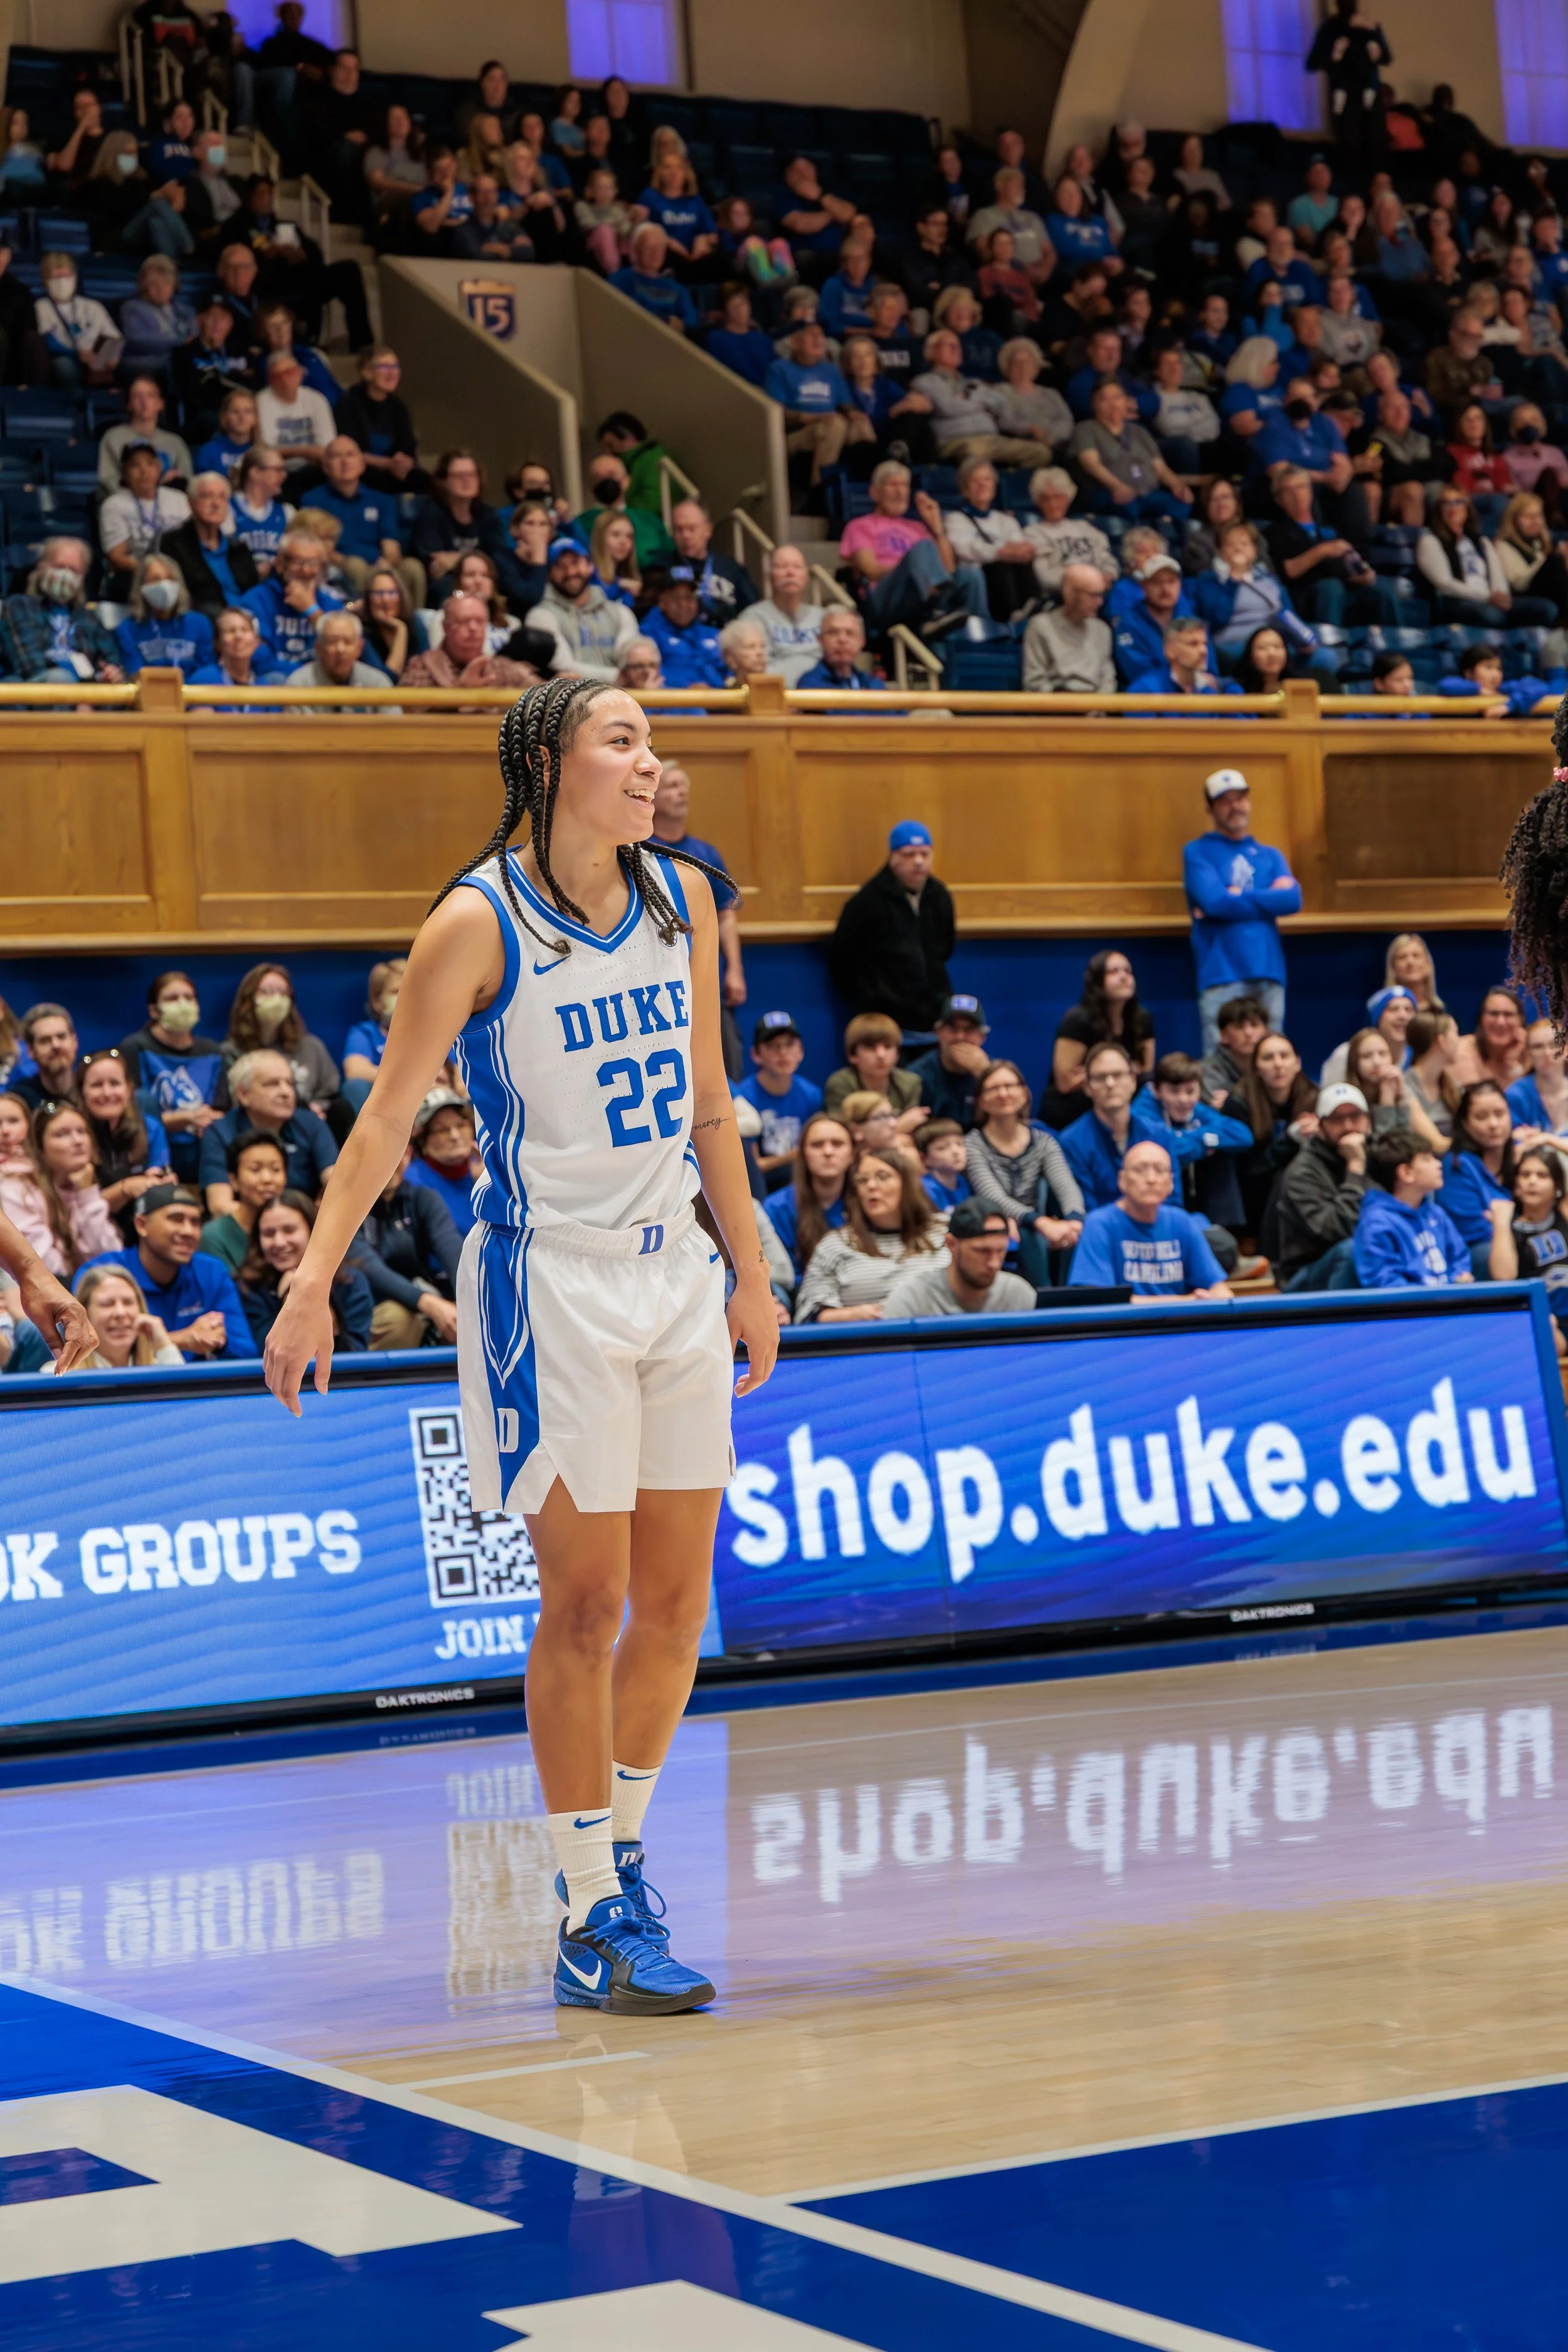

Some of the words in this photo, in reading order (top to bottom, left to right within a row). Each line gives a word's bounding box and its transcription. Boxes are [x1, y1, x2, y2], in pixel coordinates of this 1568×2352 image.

[474, 297, 511, 333] 15
[555, 980, 689, 1053] DUKE
[596, 1048, 687, 1148] 22
[692, 1117, 731, 1131] mercy
[638, 1224, 664, 1255] D
[497, 1407, 519, 1453] D
[728, 1377, 1537, 1584] shop.duke.edu
[0, 1532, 63, 1602] K
[80, 1509, 363, 1594] GROUPS
[1230, 1602, 1315, 1623] DAKTRONICS
[434, 1614, 527, 1660] JOIN
[376, 1687, 475, 1708] DAKTRONICS
